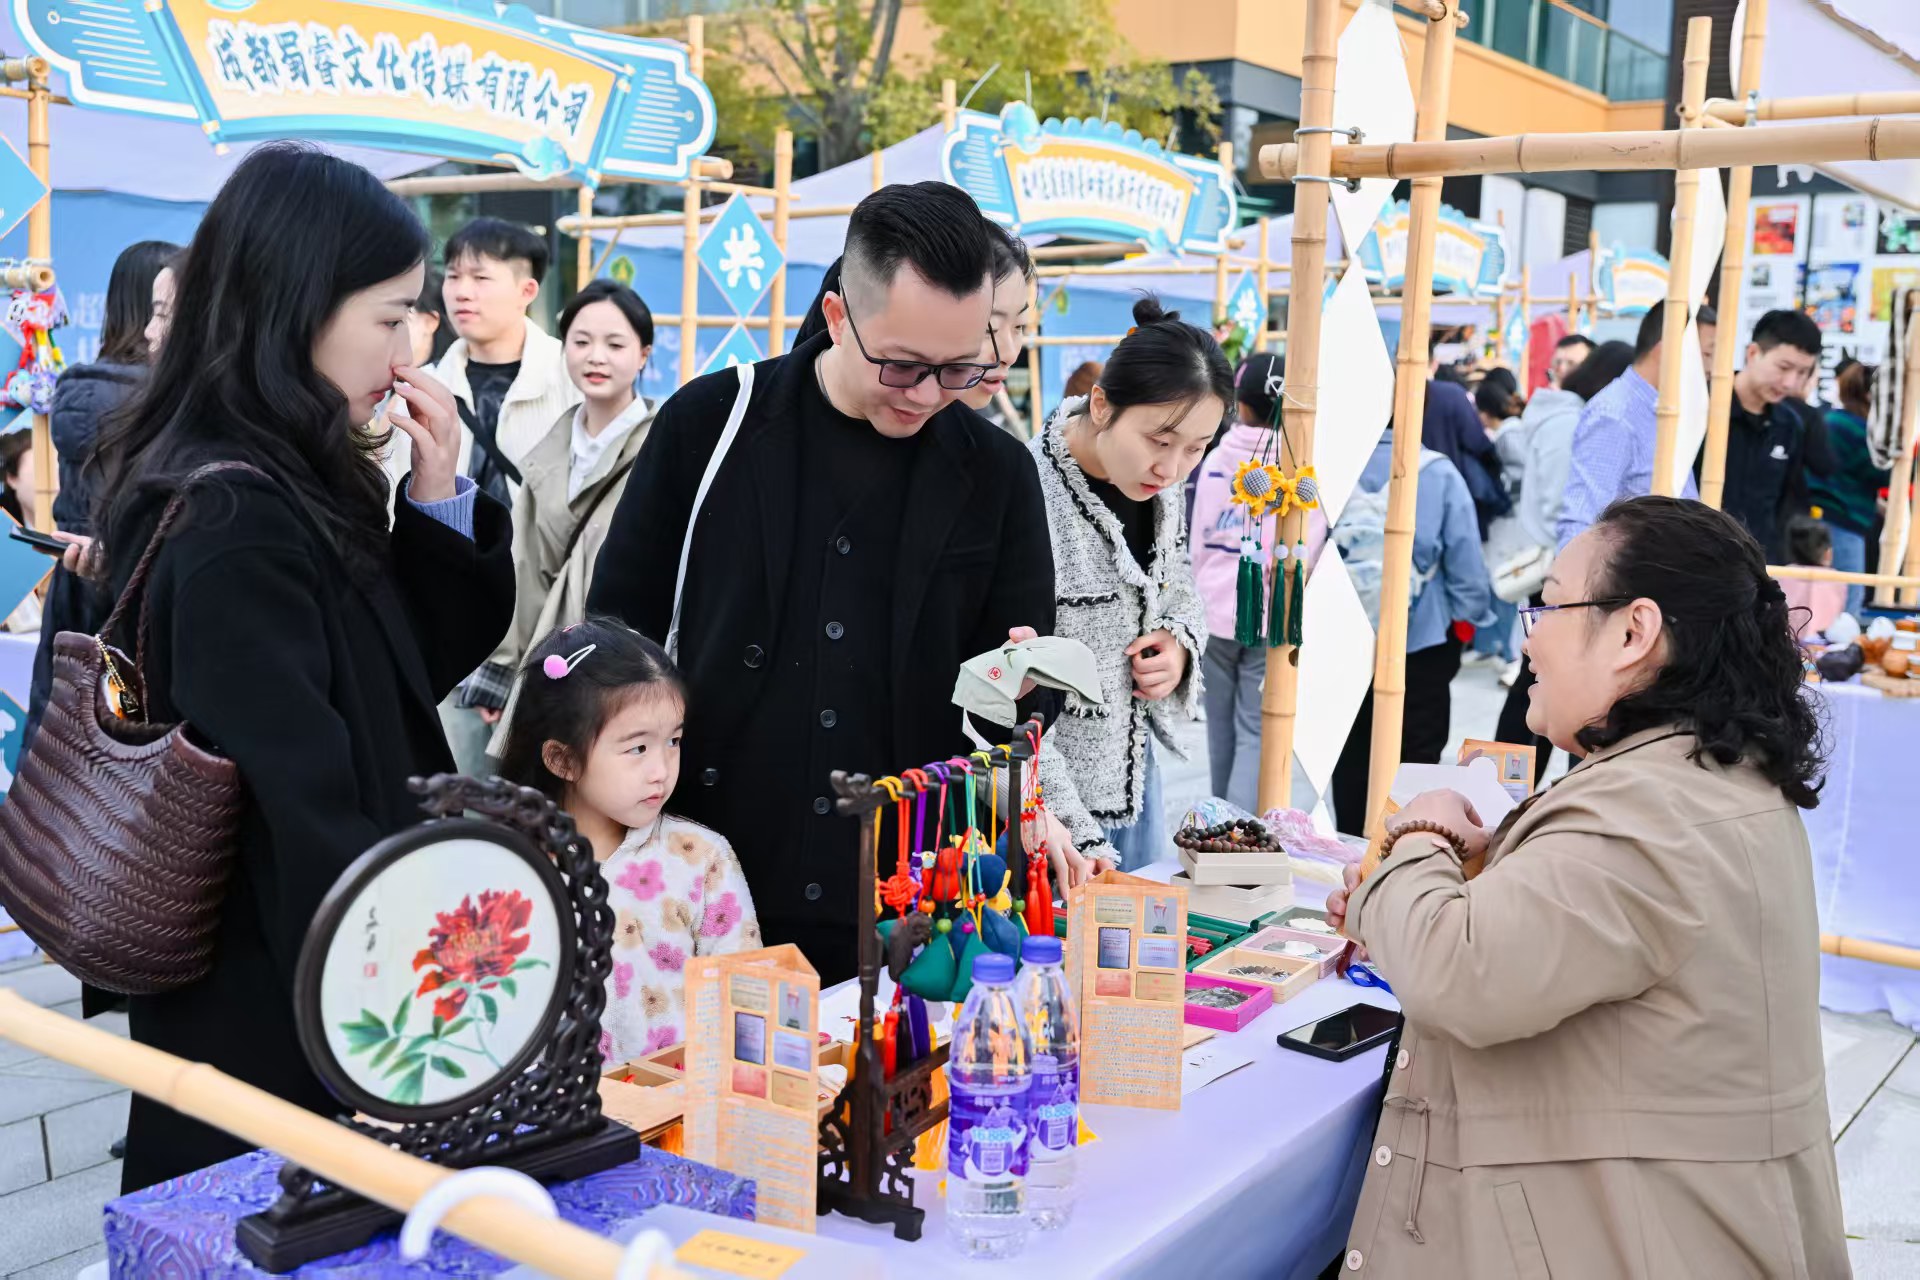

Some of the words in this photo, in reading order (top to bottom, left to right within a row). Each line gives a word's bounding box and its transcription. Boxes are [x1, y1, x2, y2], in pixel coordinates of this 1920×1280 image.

[214, 26, 588, 137] 成都蜀睿文化传媒有限公司
[719, 222, 765, 291] 共
